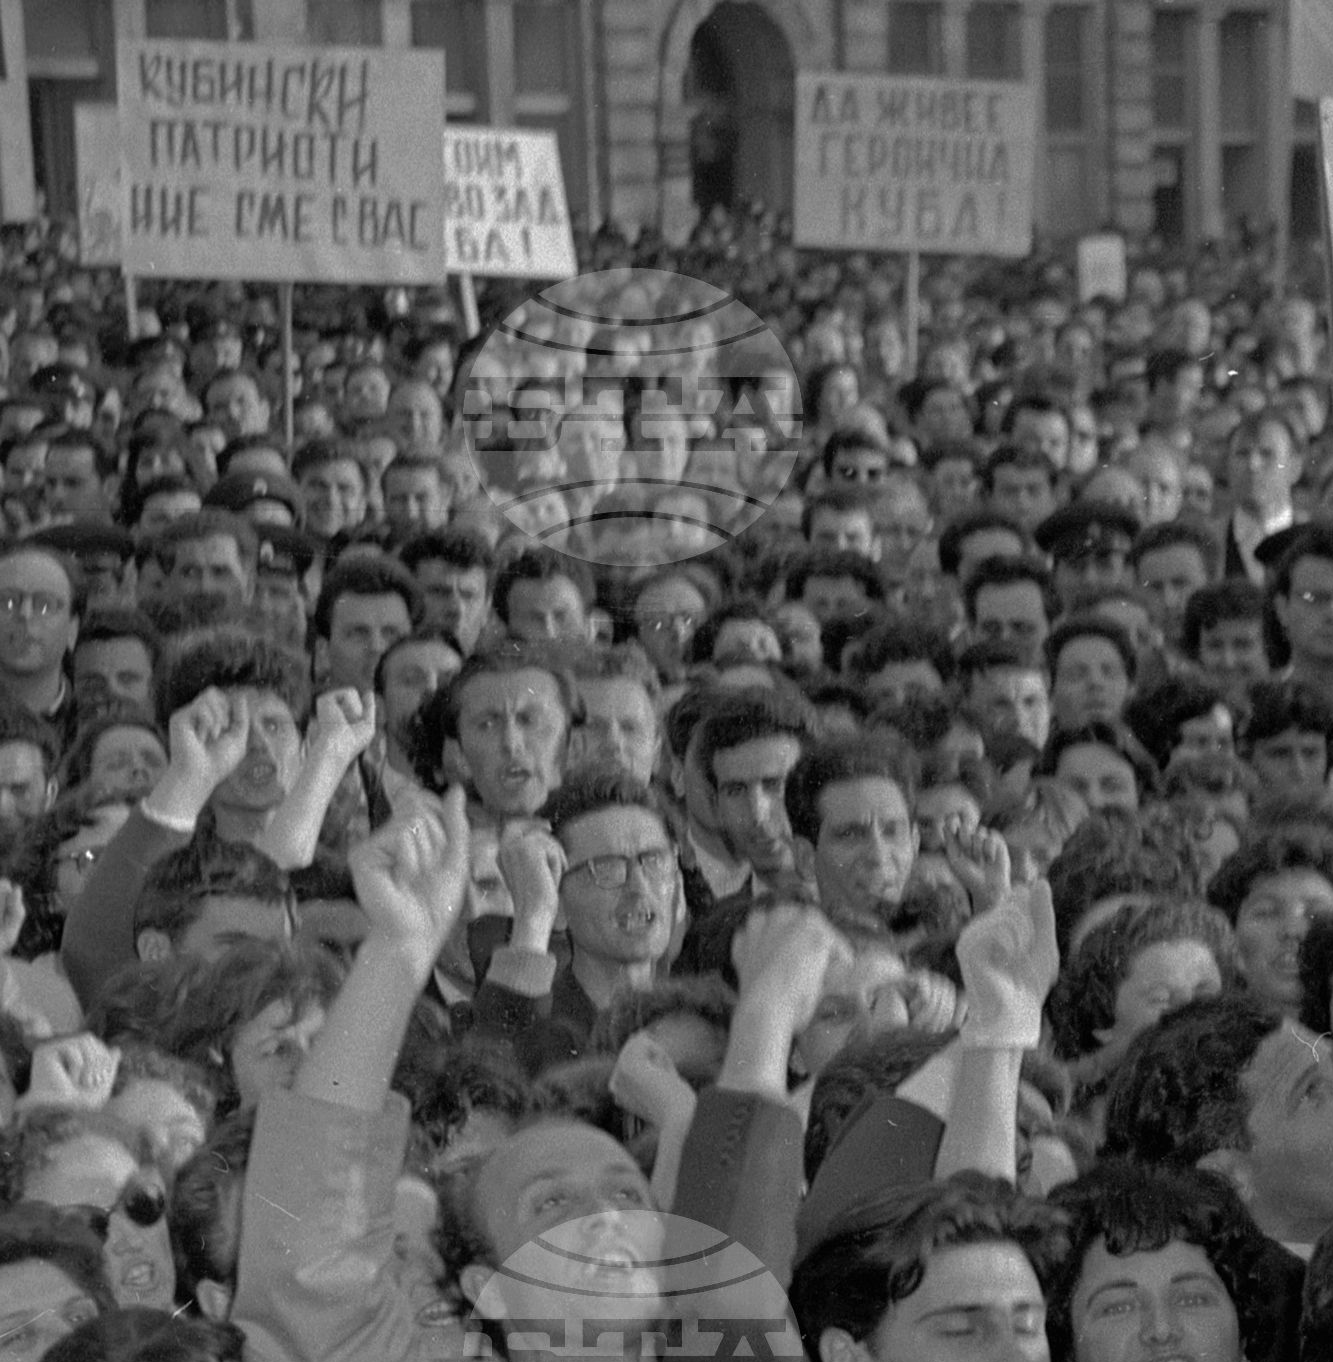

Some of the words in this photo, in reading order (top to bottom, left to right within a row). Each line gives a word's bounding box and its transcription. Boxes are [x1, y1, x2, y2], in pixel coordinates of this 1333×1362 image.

[138, 53, 369, 136] КУБИНСКИ
[811, 82, 861, 127] ДА
[149, 119, 379, 188] ПАТРИОТИ
[130, 184, 208, 239] НИЕ
[236, 189, 314, 243] СМЕ
